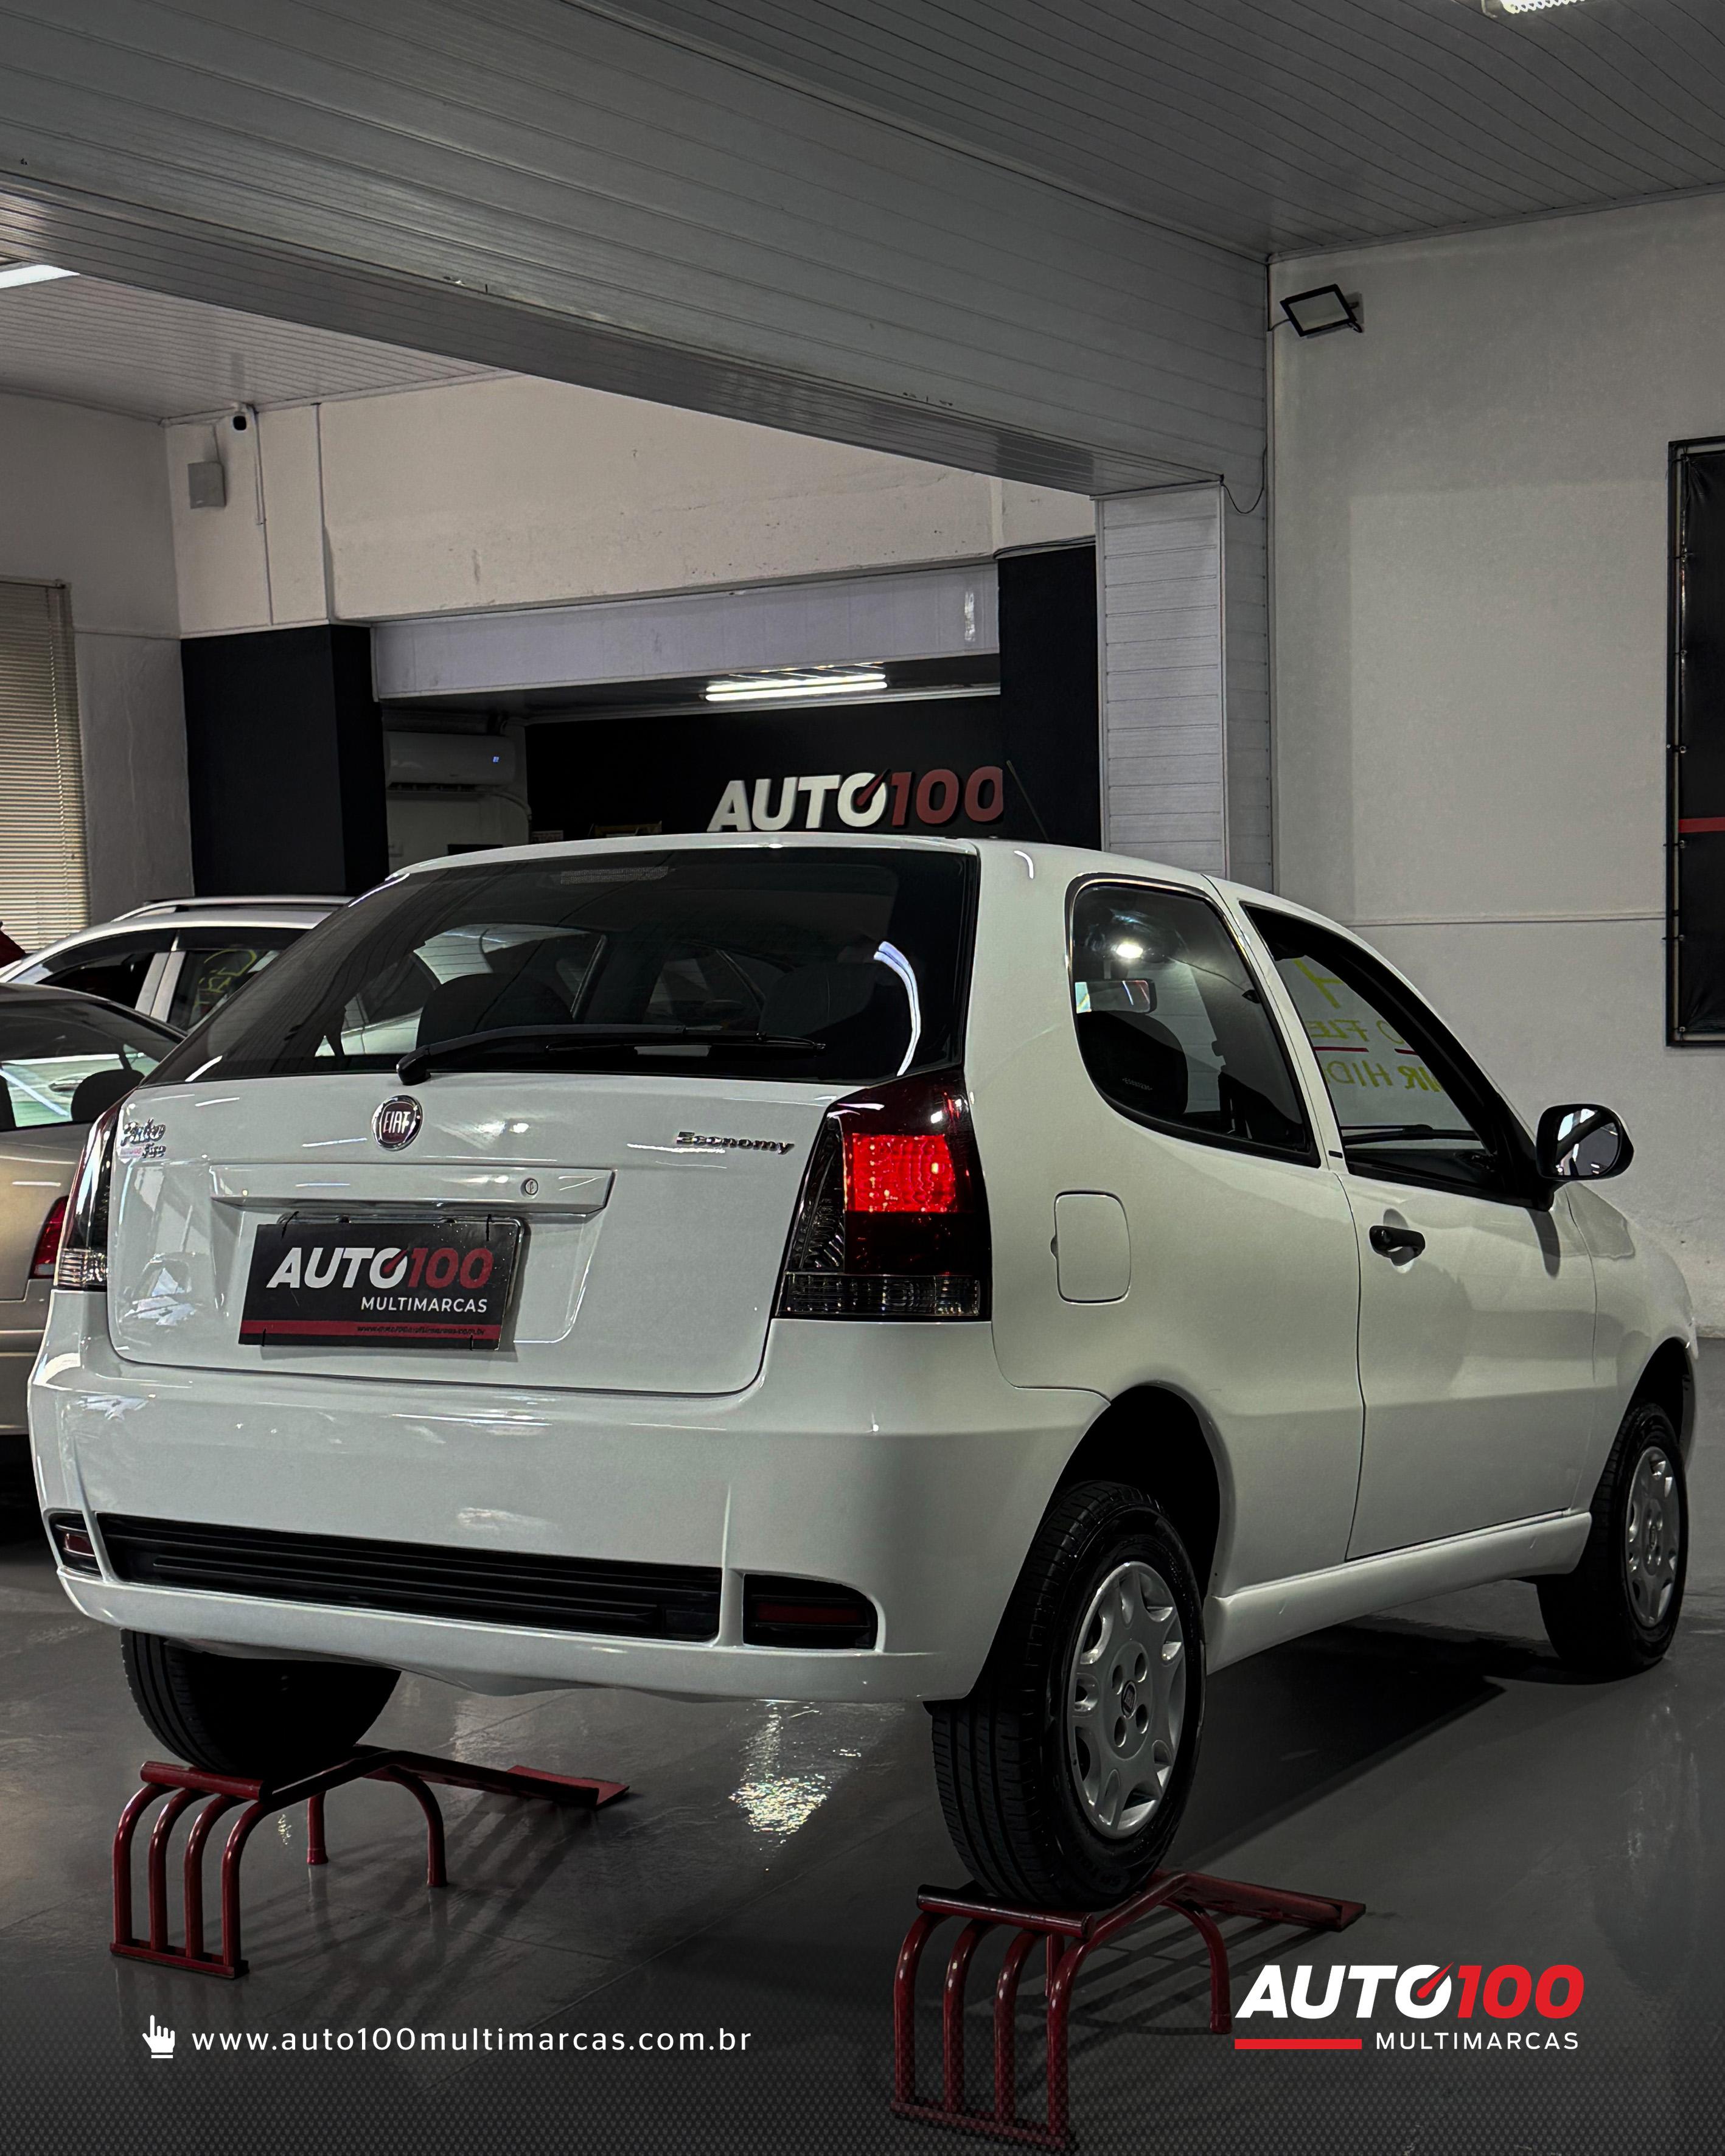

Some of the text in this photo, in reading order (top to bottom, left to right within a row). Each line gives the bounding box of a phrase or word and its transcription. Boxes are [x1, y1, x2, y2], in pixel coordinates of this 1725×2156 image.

[706, 765, 1003, 832] AUTO100
[382, 1111, 411, 1134] FIAT
[676, 1131, 795, 1155] Economy
[266, 1247, 494, 1290] AUTO100
[361, 1296, 487, 1313] MULTIMARCAS
